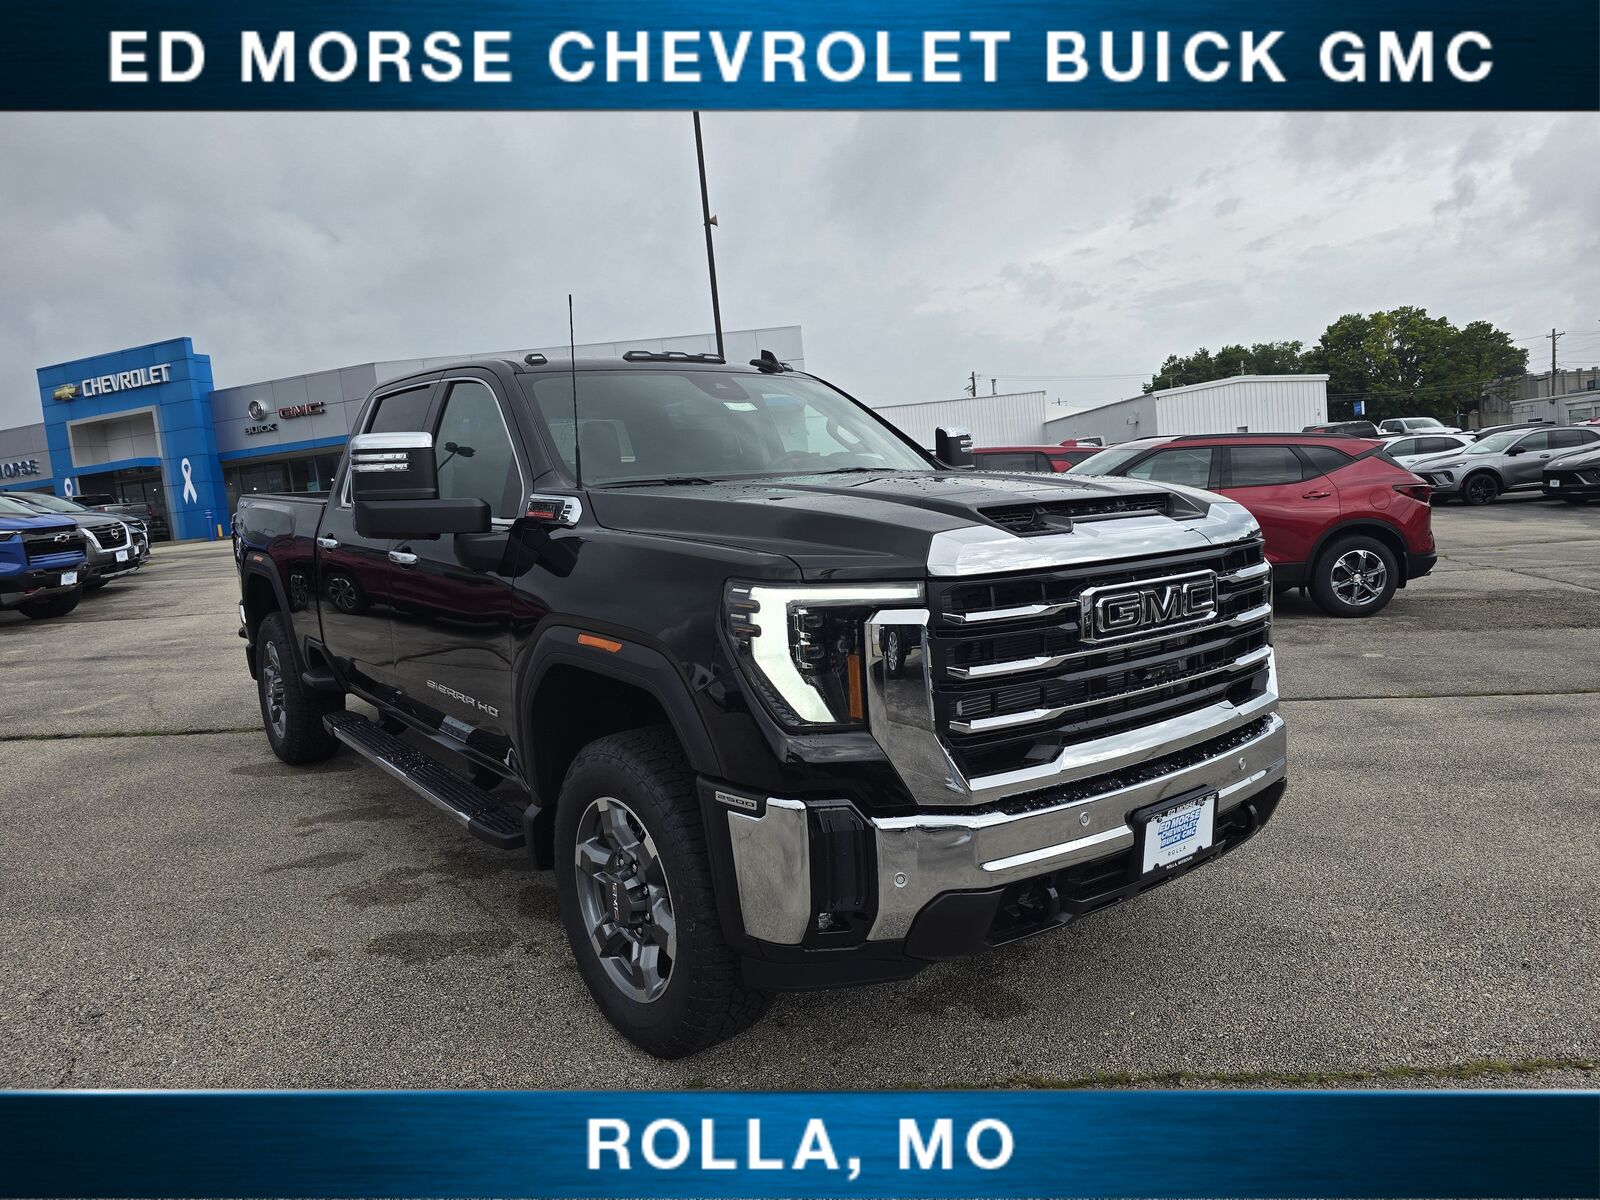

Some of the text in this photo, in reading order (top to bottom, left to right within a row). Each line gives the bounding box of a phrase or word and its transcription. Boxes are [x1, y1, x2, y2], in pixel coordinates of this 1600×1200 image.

[81, 363, 171, 397] CHEVROLET
[279, 401, 325, 419] GMC
[245, 423, 278, 435] BUICK
[1095, 579, 1214, 632] GMC
[426, 679, 499, 718] SIERRA HD
[717, 793, 756, 808] 2500
[1159, 820, 1172, 834] ED
[1171, 809, 1201, 828] MORSE
[1161, 820, 1197, 839] CHEVROLET
[1161, 827, 1197, 847] BUICK GMC
[1167, 845, 1187, 856] ROLLA
